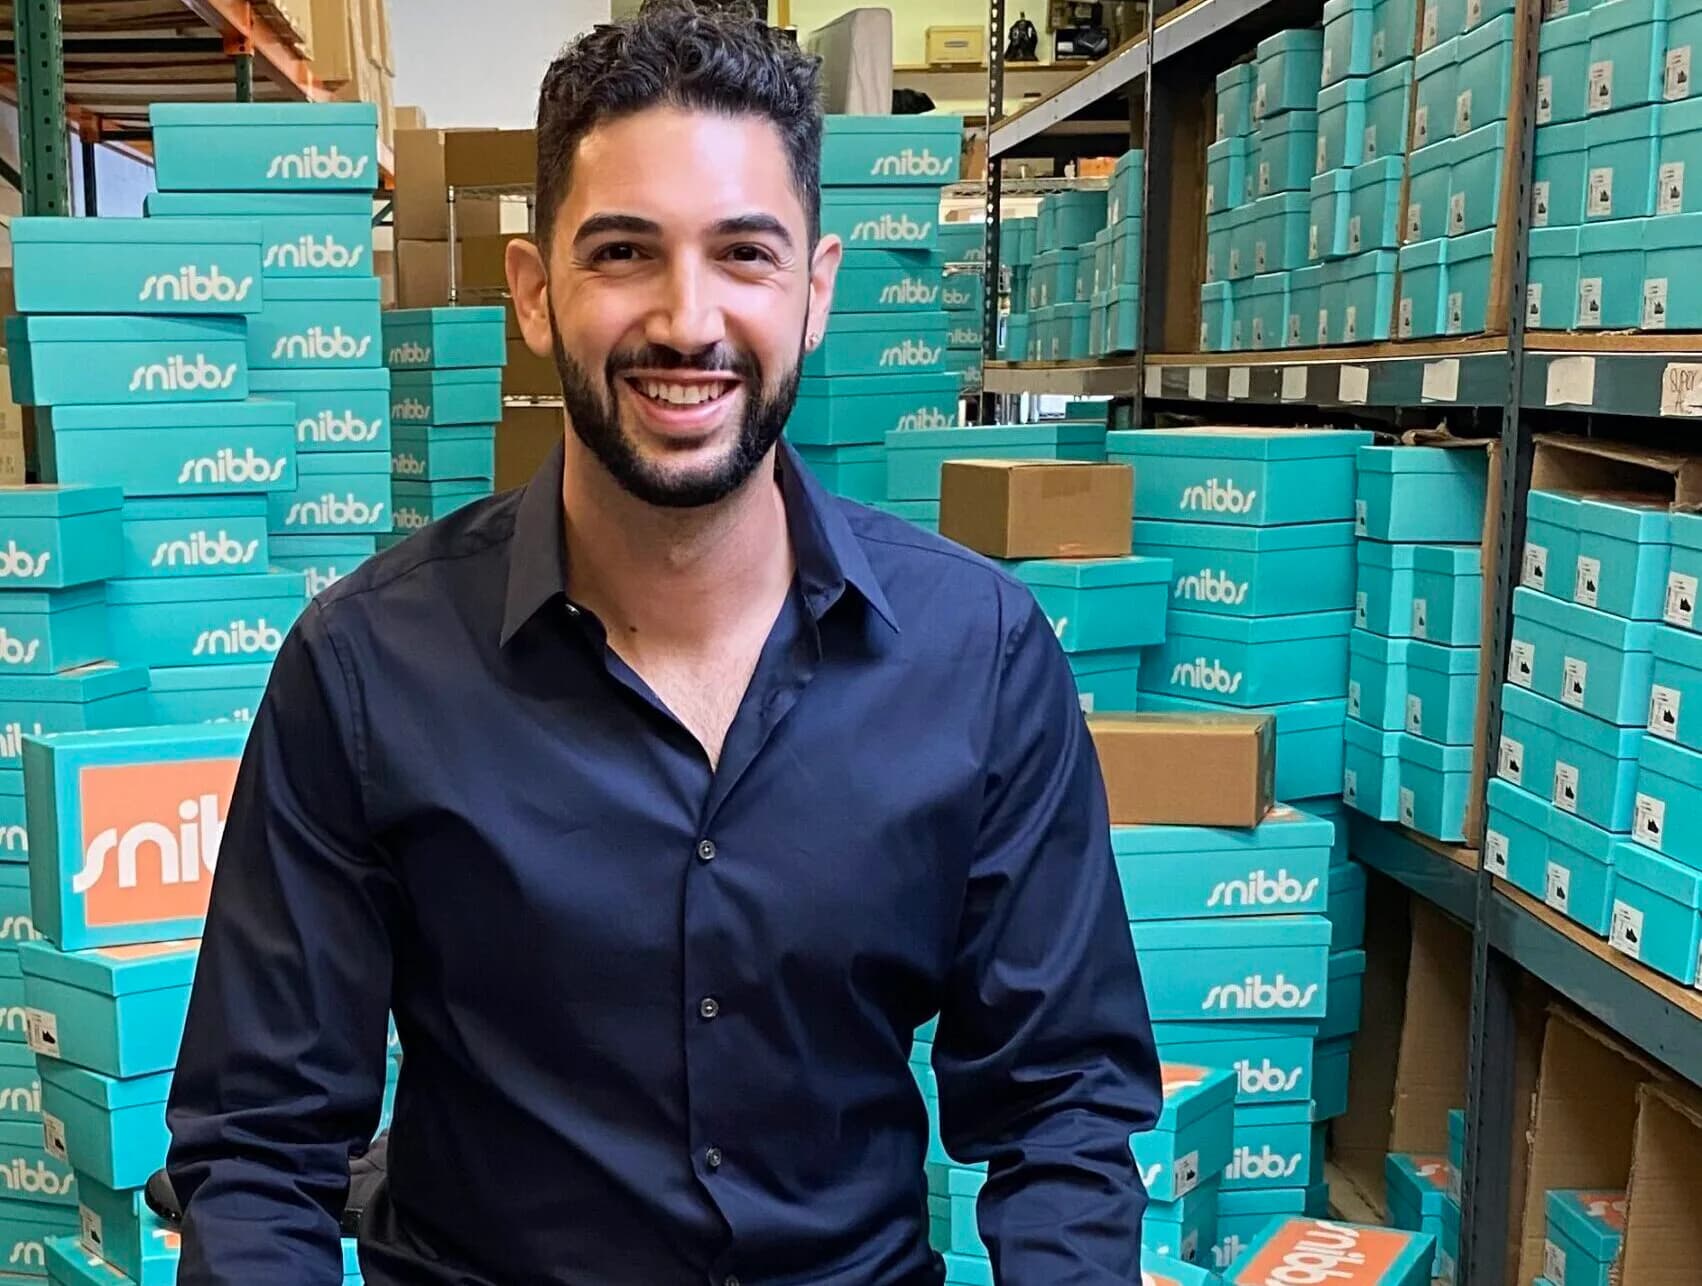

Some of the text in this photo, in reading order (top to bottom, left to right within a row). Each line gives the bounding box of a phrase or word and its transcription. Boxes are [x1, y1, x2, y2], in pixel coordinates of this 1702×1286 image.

[266, 145, 369, 179] snibbs
[871, 148, 953, 176] snibbs
[850, 213, 931, 241] snibbs
[263, 235, 364, 268] snibbs
[139, 265, 253, 301] snibbs
[880, 278, 938, 305] snibbs
[942, 287, 971, 304] bbs
[272, 326, 371, 360] snibbs
[880, 339, 942, 367] snibbs
[129, 353, 237, 391] snibbs
[297, 410, 382, 443] nibbs
[178, 447, 287, 484] snibbs
[392, 453, 425, 474] nibbs
[285, 493, 384, 526] snibbs
[1179, 478, 1256, 514] snibbs
[393, 507, 430, 529] nibbs
[151, 530, 259, 567] snibbs
[1174, 567, 1249, 605] snibbs
[192, 618, 283, 656] snibb
[1170, 656, 1242, 694] snibbs
[1207, 868, 1319, 907] snibbs
[1201, 973, 1318, 1010] snibbs
[1232, 1058, 1303, 1093] ibbs
[0, 1081, 41, 1112] sni
[0, 1158, 74, 1195] nibbs
